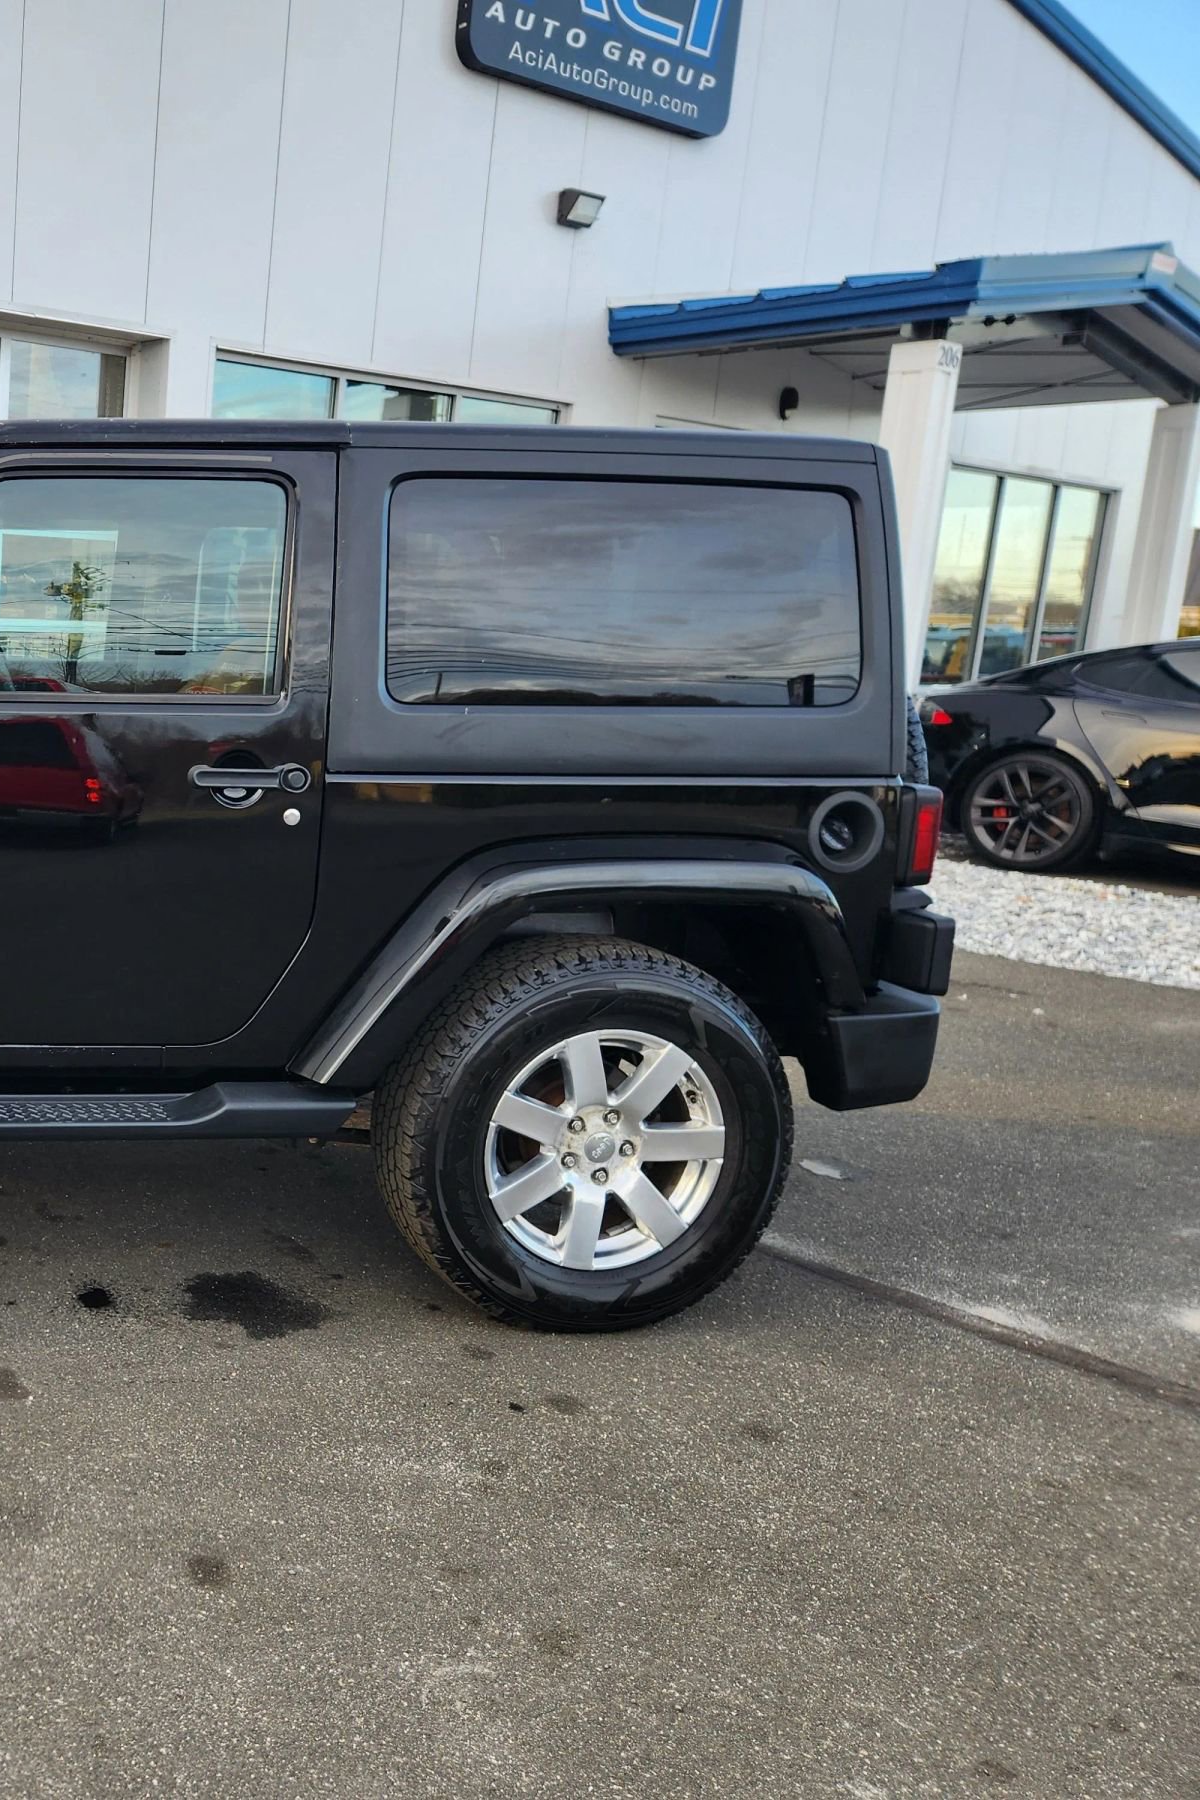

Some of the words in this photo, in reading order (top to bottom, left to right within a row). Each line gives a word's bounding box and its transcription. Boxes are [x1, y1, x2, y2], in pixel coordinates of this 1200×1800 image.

[485, 1, 587, 48] AUTO
[602, 41, 717, 91] GROUP
[508, 42, 698, 118] AciAutoGroup.com
[938, 346, 960, 368] 206
